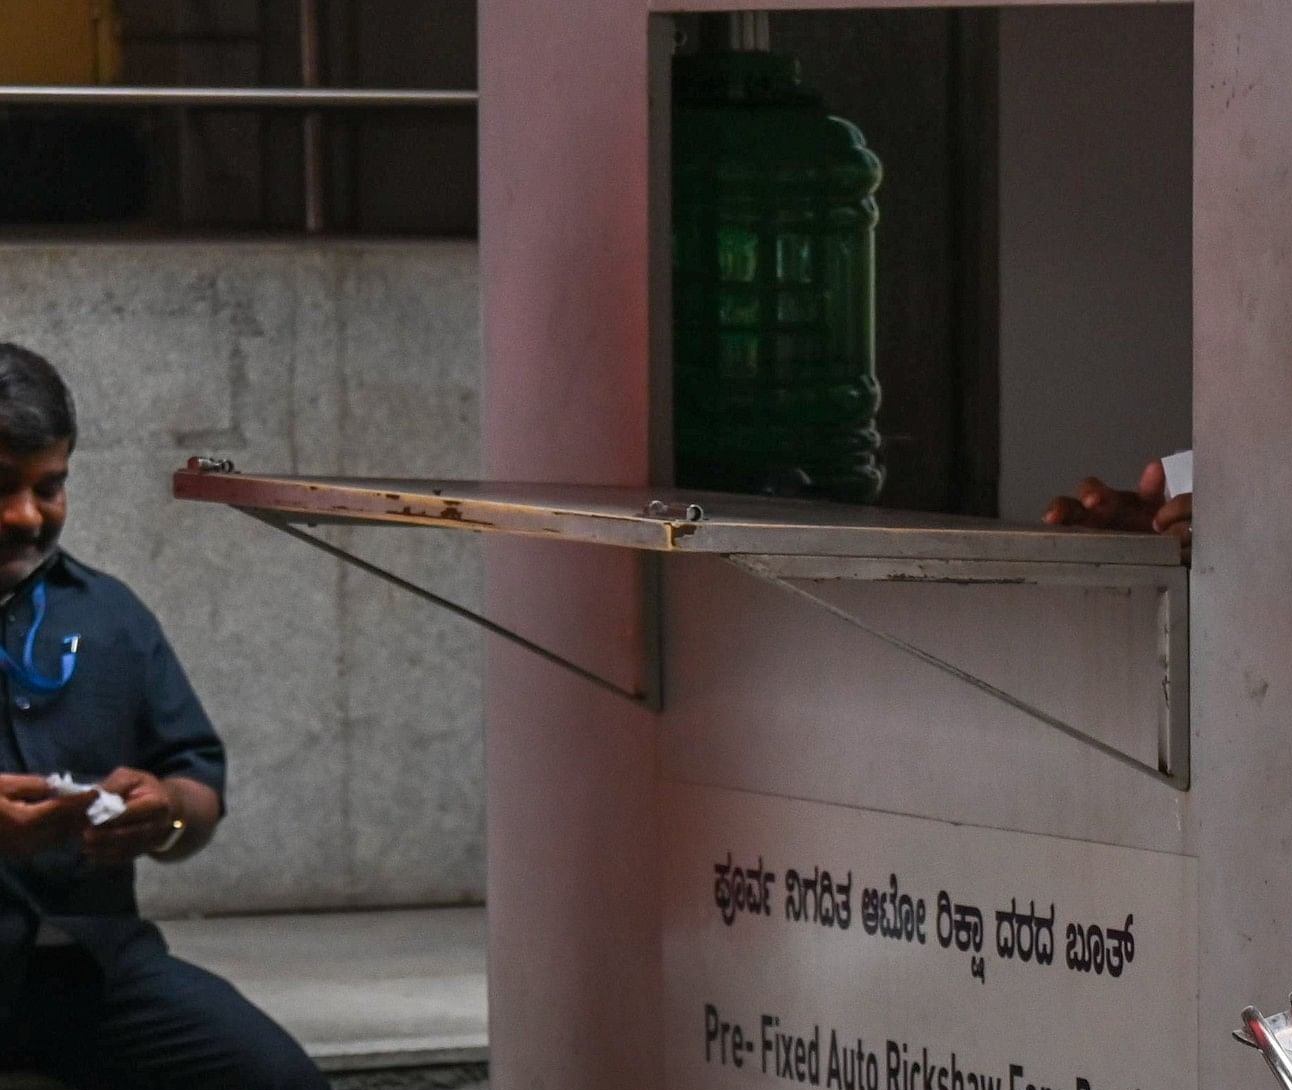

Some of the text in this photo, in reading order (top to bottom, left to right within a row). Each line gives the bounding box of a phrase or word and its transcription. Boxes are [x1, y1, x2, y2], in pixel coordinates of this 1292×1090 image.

[785, 865, 851, 930] ನಿಗದಿತ
[861, 873, 926, 945] ಆಟೋ
[936, 890, 985, 985] ರಿಕ್ಷಾ
[995, 897, 1054, 966] ದರದ
[1066, 913, 1135, 978] ಬೂತ್
[704, 1003, 753, 1068] Pre-
[761, 1014, 819, 1086] Fixed
